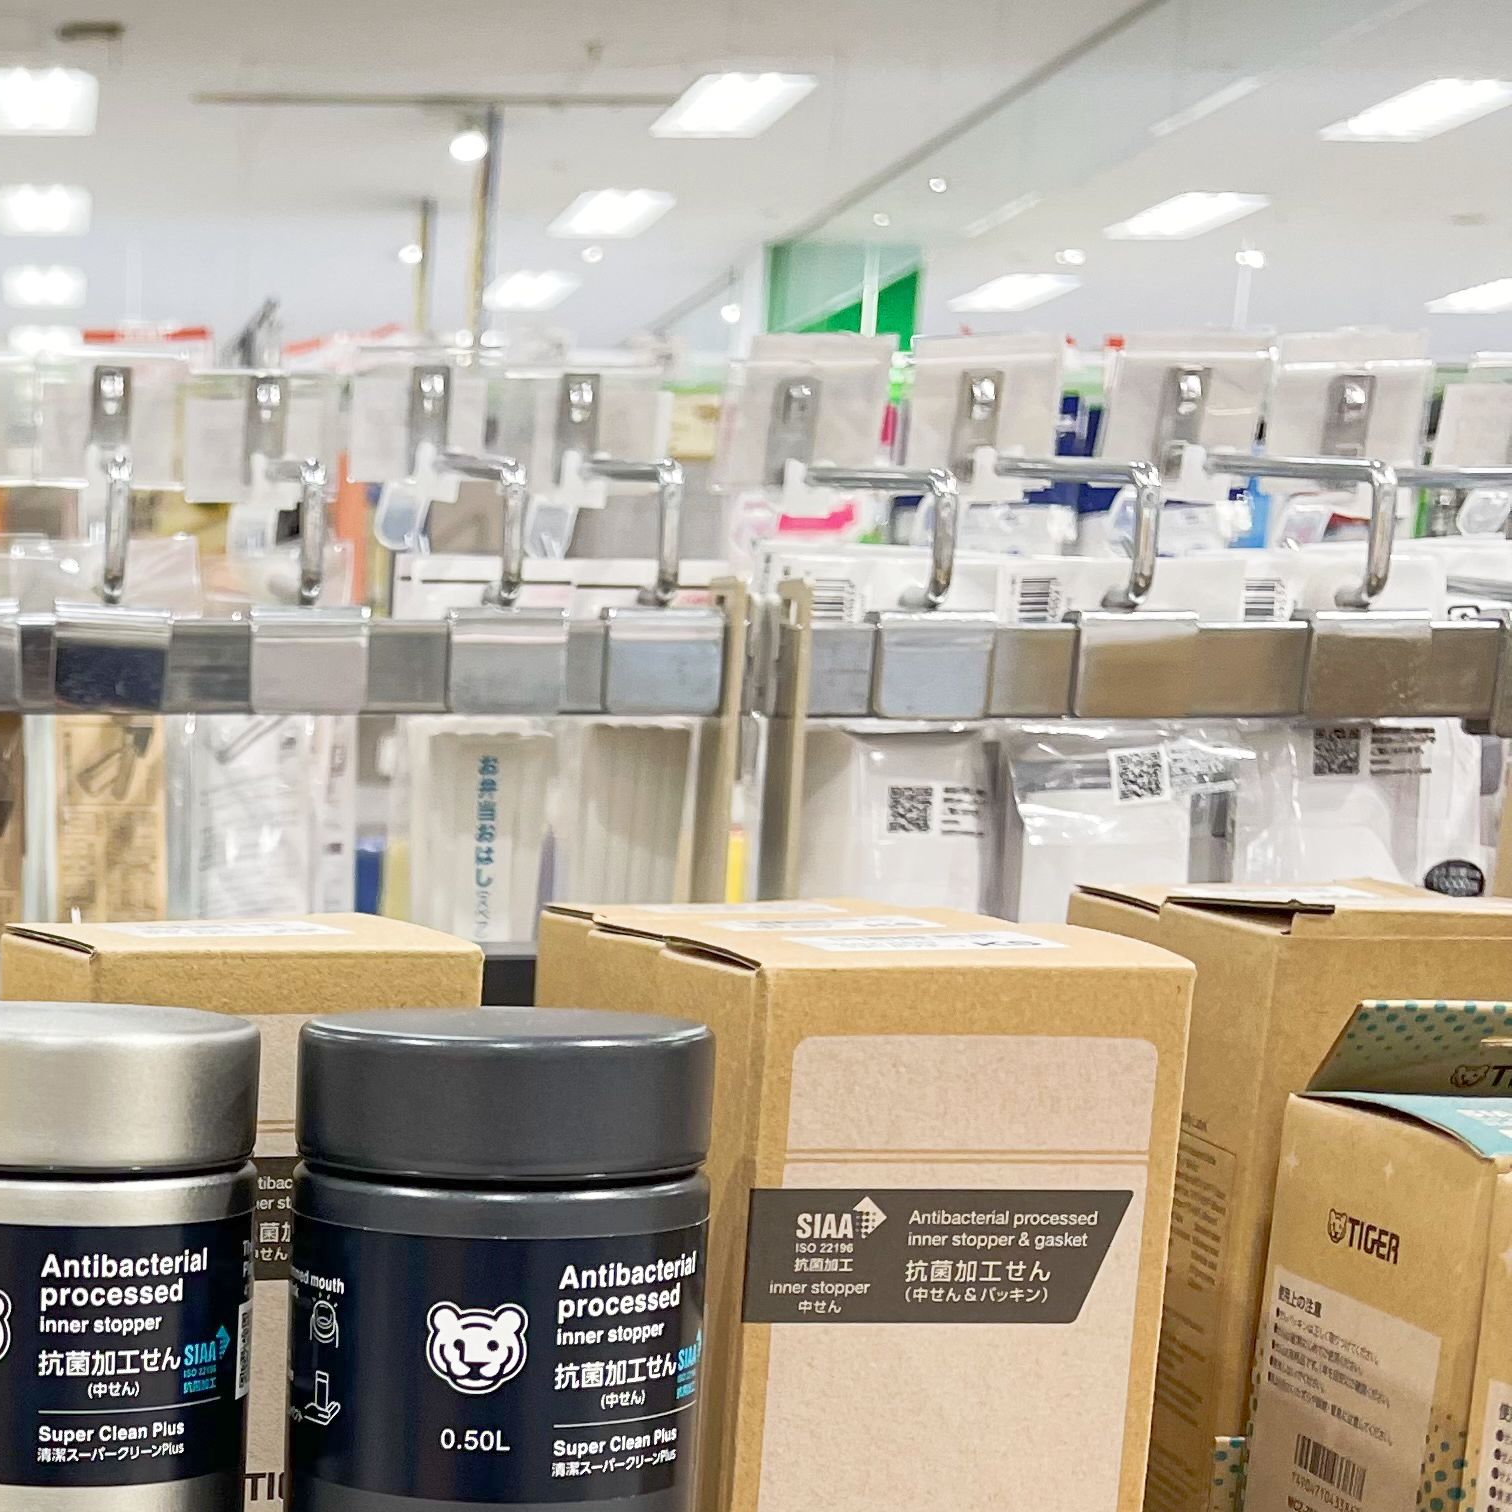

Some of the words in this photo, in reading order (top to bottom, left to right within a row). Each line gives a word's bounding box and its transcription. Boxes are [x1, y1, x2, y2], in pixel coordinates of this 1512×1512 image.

[796, 1213, 854, 1239] SIAA
[909, 1209, 1009, 1226] Antibacterial
[1013, 1210, 1098, 1228] processed
[796, 1243, 816, 1254] ISO
[819, 1243, 854, 1254] 22196
[907, 1232, 949, 1247] inner
[952, 1233, 1015, 1250] stopper
[1018, 1233, 1030, 1247] &
[1034, 1232, 1088, 1249] gasket
[1348, 1216, 1400, 1265] TIGER
[41, 1247, 208, 1279] Antibacterial
[559, 1251, 697, 1290] Antibacterial
[794, 1258, 853, 1273] 抗菌加工
[905, 1260, 1051, 1283] 抗菌加工せん
[41, 1279, 183, 1311] processed
[769, 1281, 808, 1294] inner
[811, 1280, 871, 1297] stopper
[558, 1283, 681, 1324] processed
[798, 1300, 842, 1315] 中せん
[40, 1317, 89, 1334] inner
[93, 1314, 162, 1335] stopper
[557, 1328, 602, 1346] inner
[608, 1321, 665, 1344] stopper
[38, 1347, 180, 1377] 抗菌加工せん
[184, 1341, 216, 1366] SIAA
[554, 1351, 676, 1391] 抗菌加工せん
[88, 1381, 140, 1399] (中せん)
[600, 1389, 646, 1409] (中せん)
[39, 1424, 94, 1442] Super
[99, 1423, 147, 1441] Clean
[153, 1420, 185, 1437] Plus
[440, 1429, 510, 1452] 0.50L
[553, 1437, 606, 1457] Super
[610, 1433, 650, 1452] Clean
[654, 1426, 677, 1446] Plus
